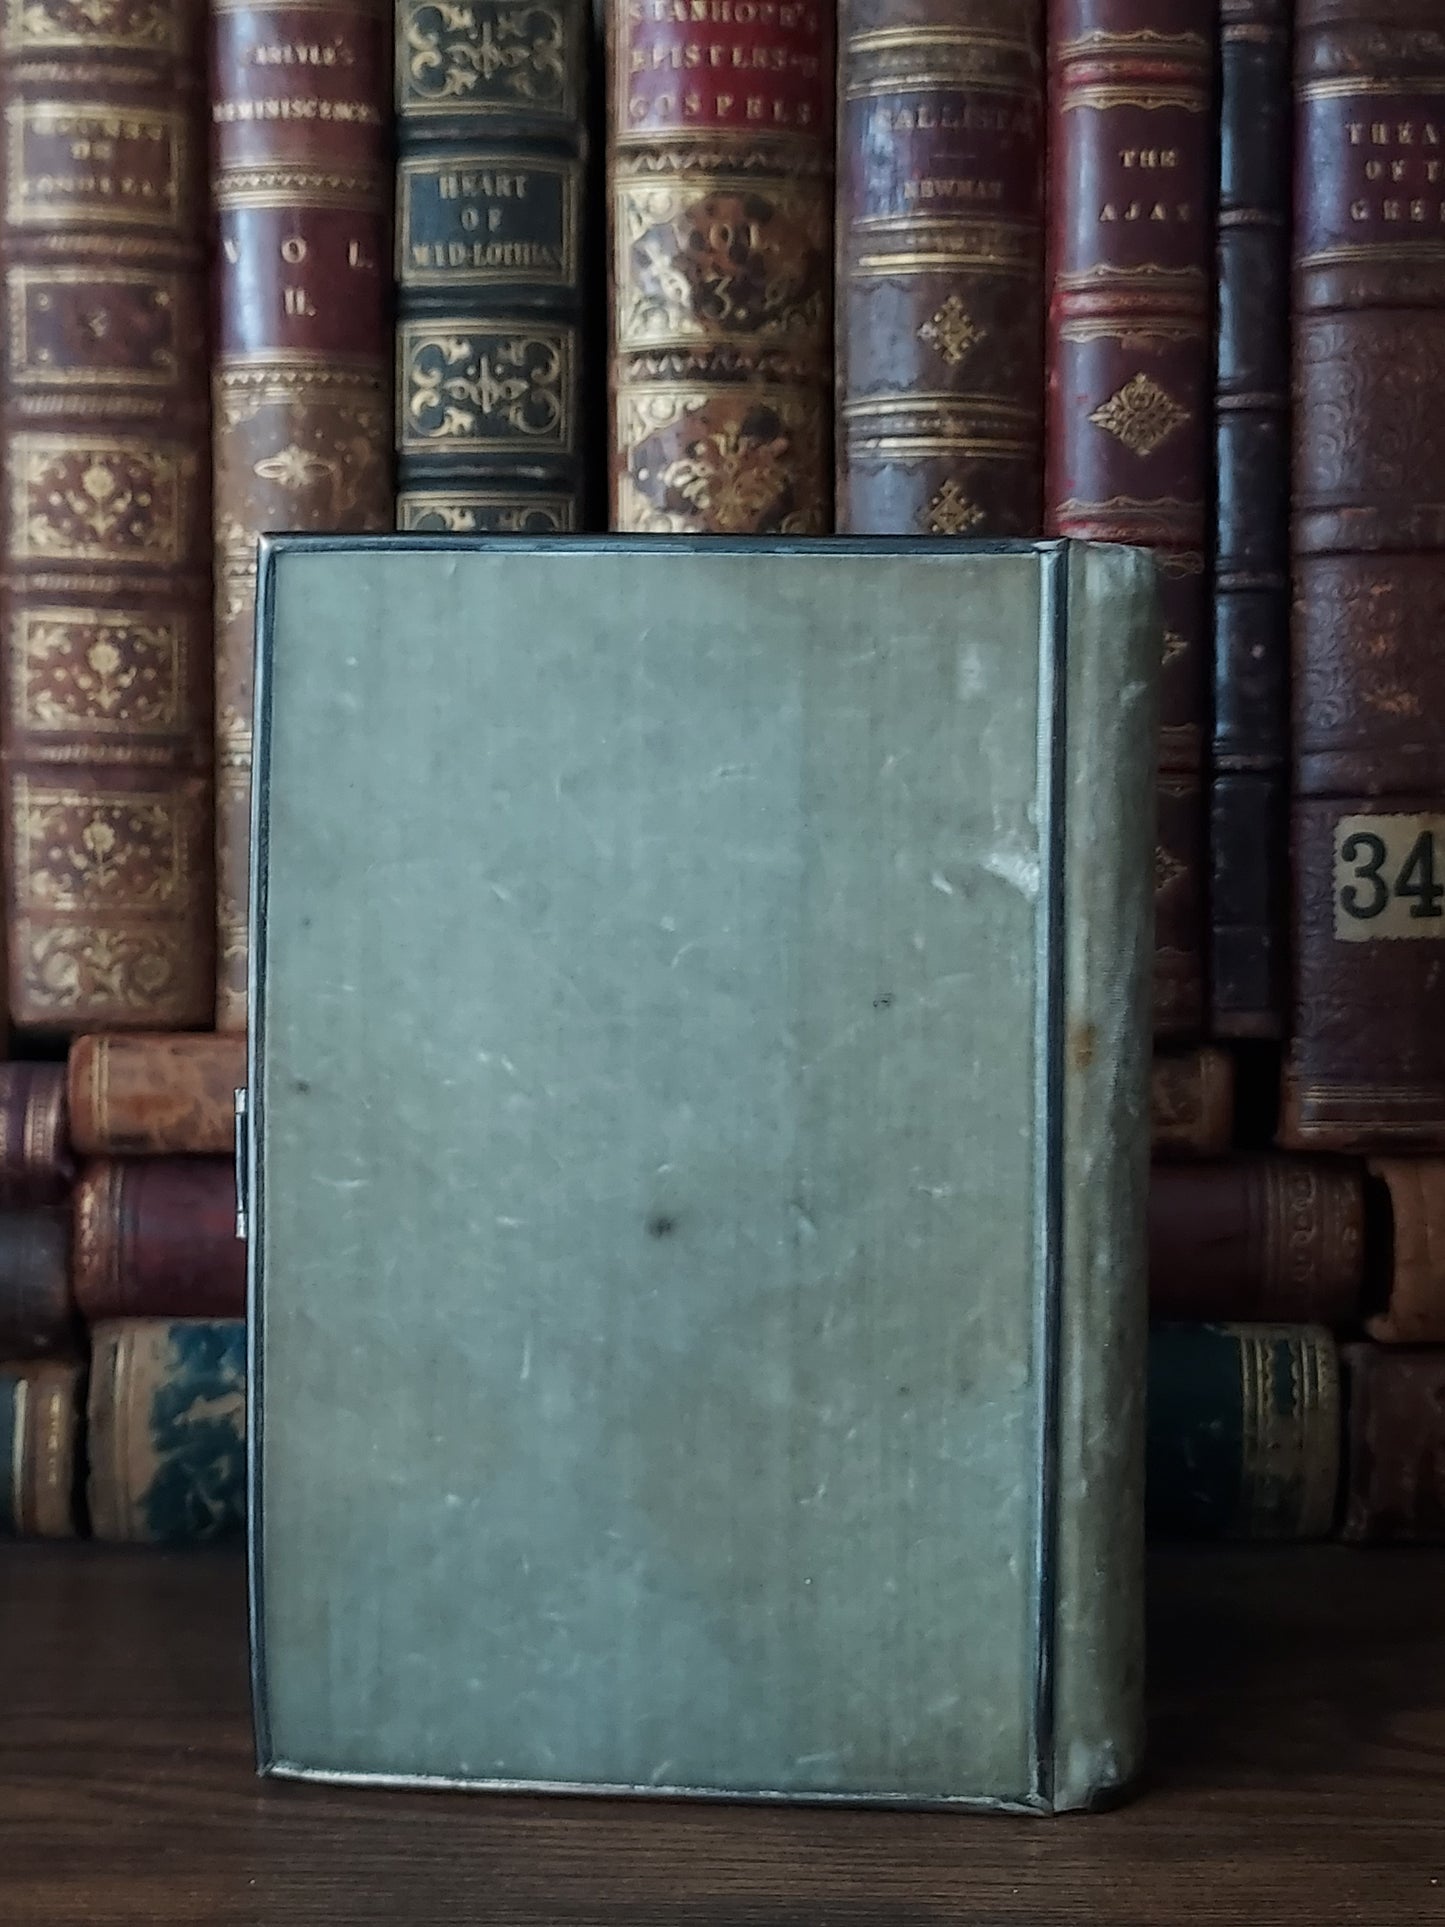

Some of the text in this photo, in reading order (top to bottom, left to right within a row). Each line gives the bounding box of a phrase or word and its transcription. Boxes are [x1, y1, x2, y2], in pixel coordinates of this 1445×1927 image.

[1119, 149, 1178, 168] THE
[439, 174, 528, 199] HEART
[461, 205, 503, 232] OF
[1340, 831, 1444, 919] 34
